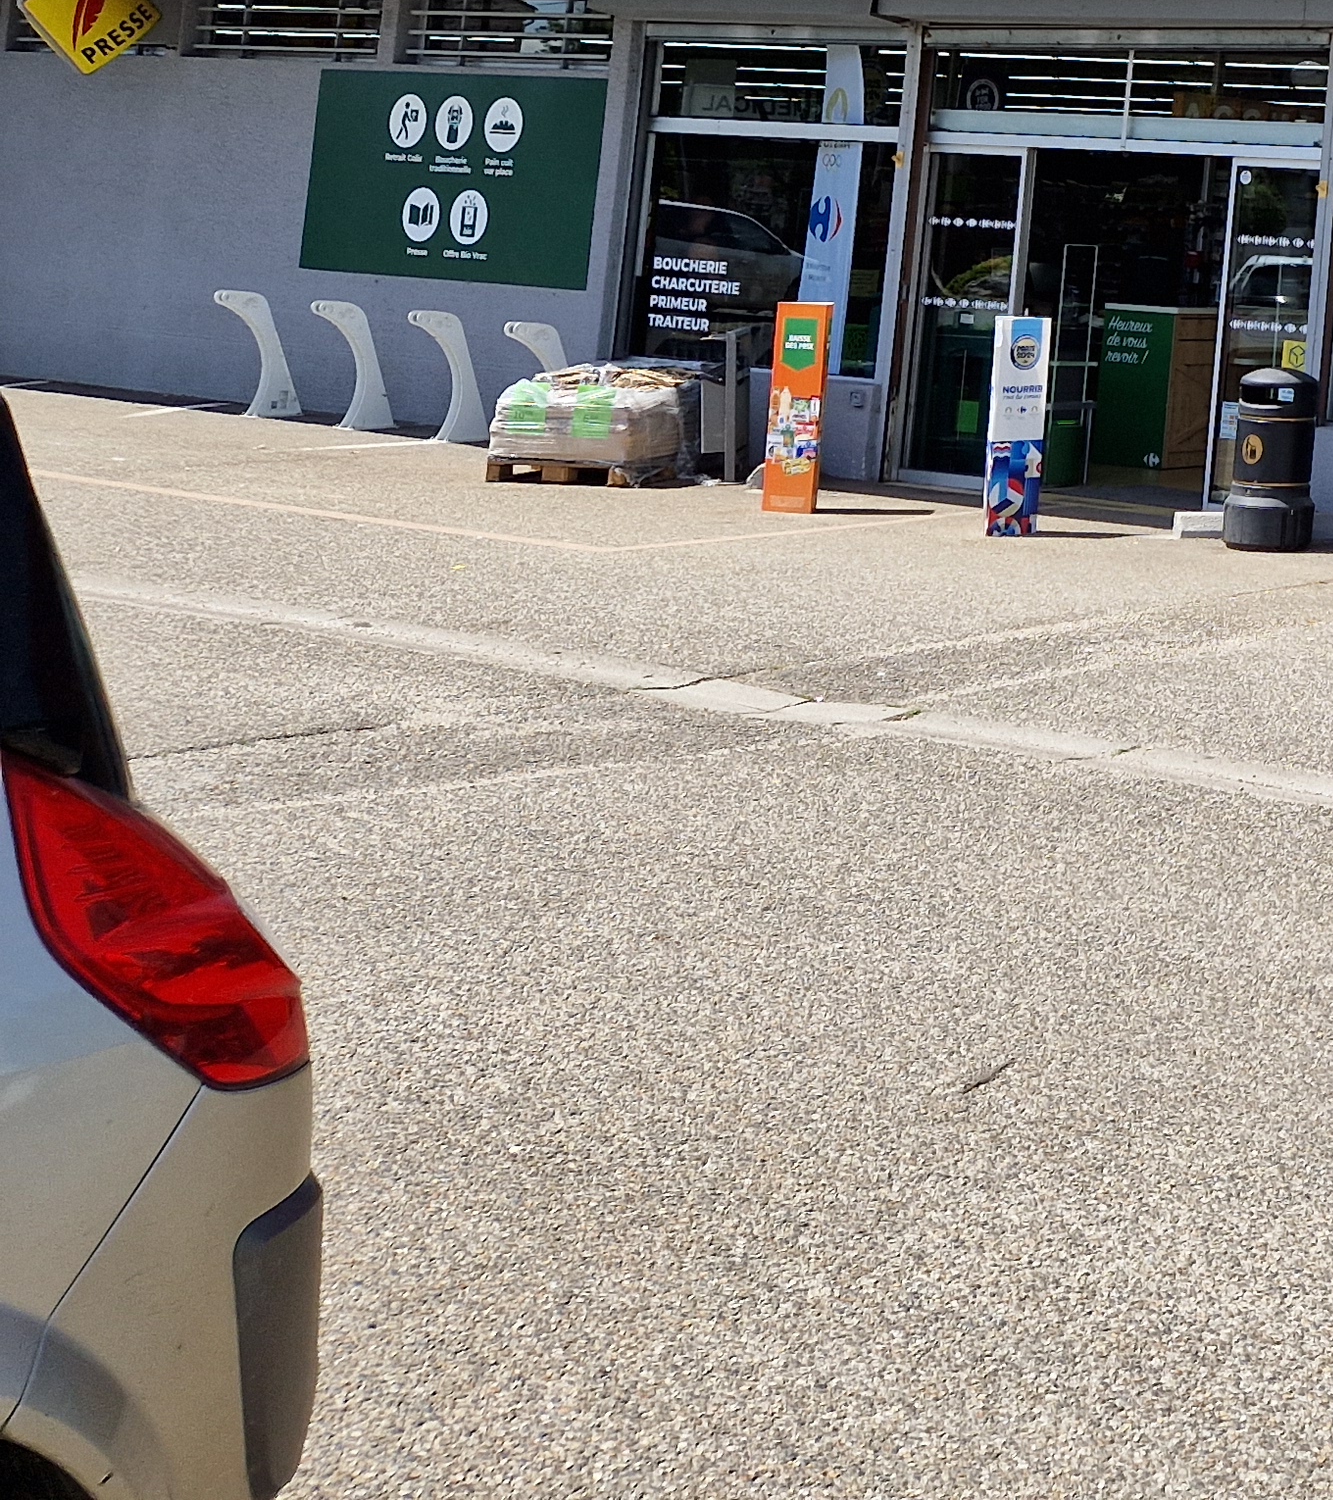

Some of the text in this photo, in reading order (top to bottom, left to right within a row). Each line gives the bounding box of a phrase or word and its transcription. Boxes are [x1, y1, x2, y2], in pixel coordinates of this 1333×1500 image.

[80, 3, 153, 65] PRESSE
[653, 256, 728, 275] BOUCHERIE
[651, 275, 741, 296] CHARCUTERIE
[649, 294, 708, 313] PRIMEUR
[647, 313, 710, 332] TRAITEUR
[1108, 315, 1153, 333] Heureux
[1106, 331, 1149, 349] de vous
[1104, 350, 1139, 364] revoir
